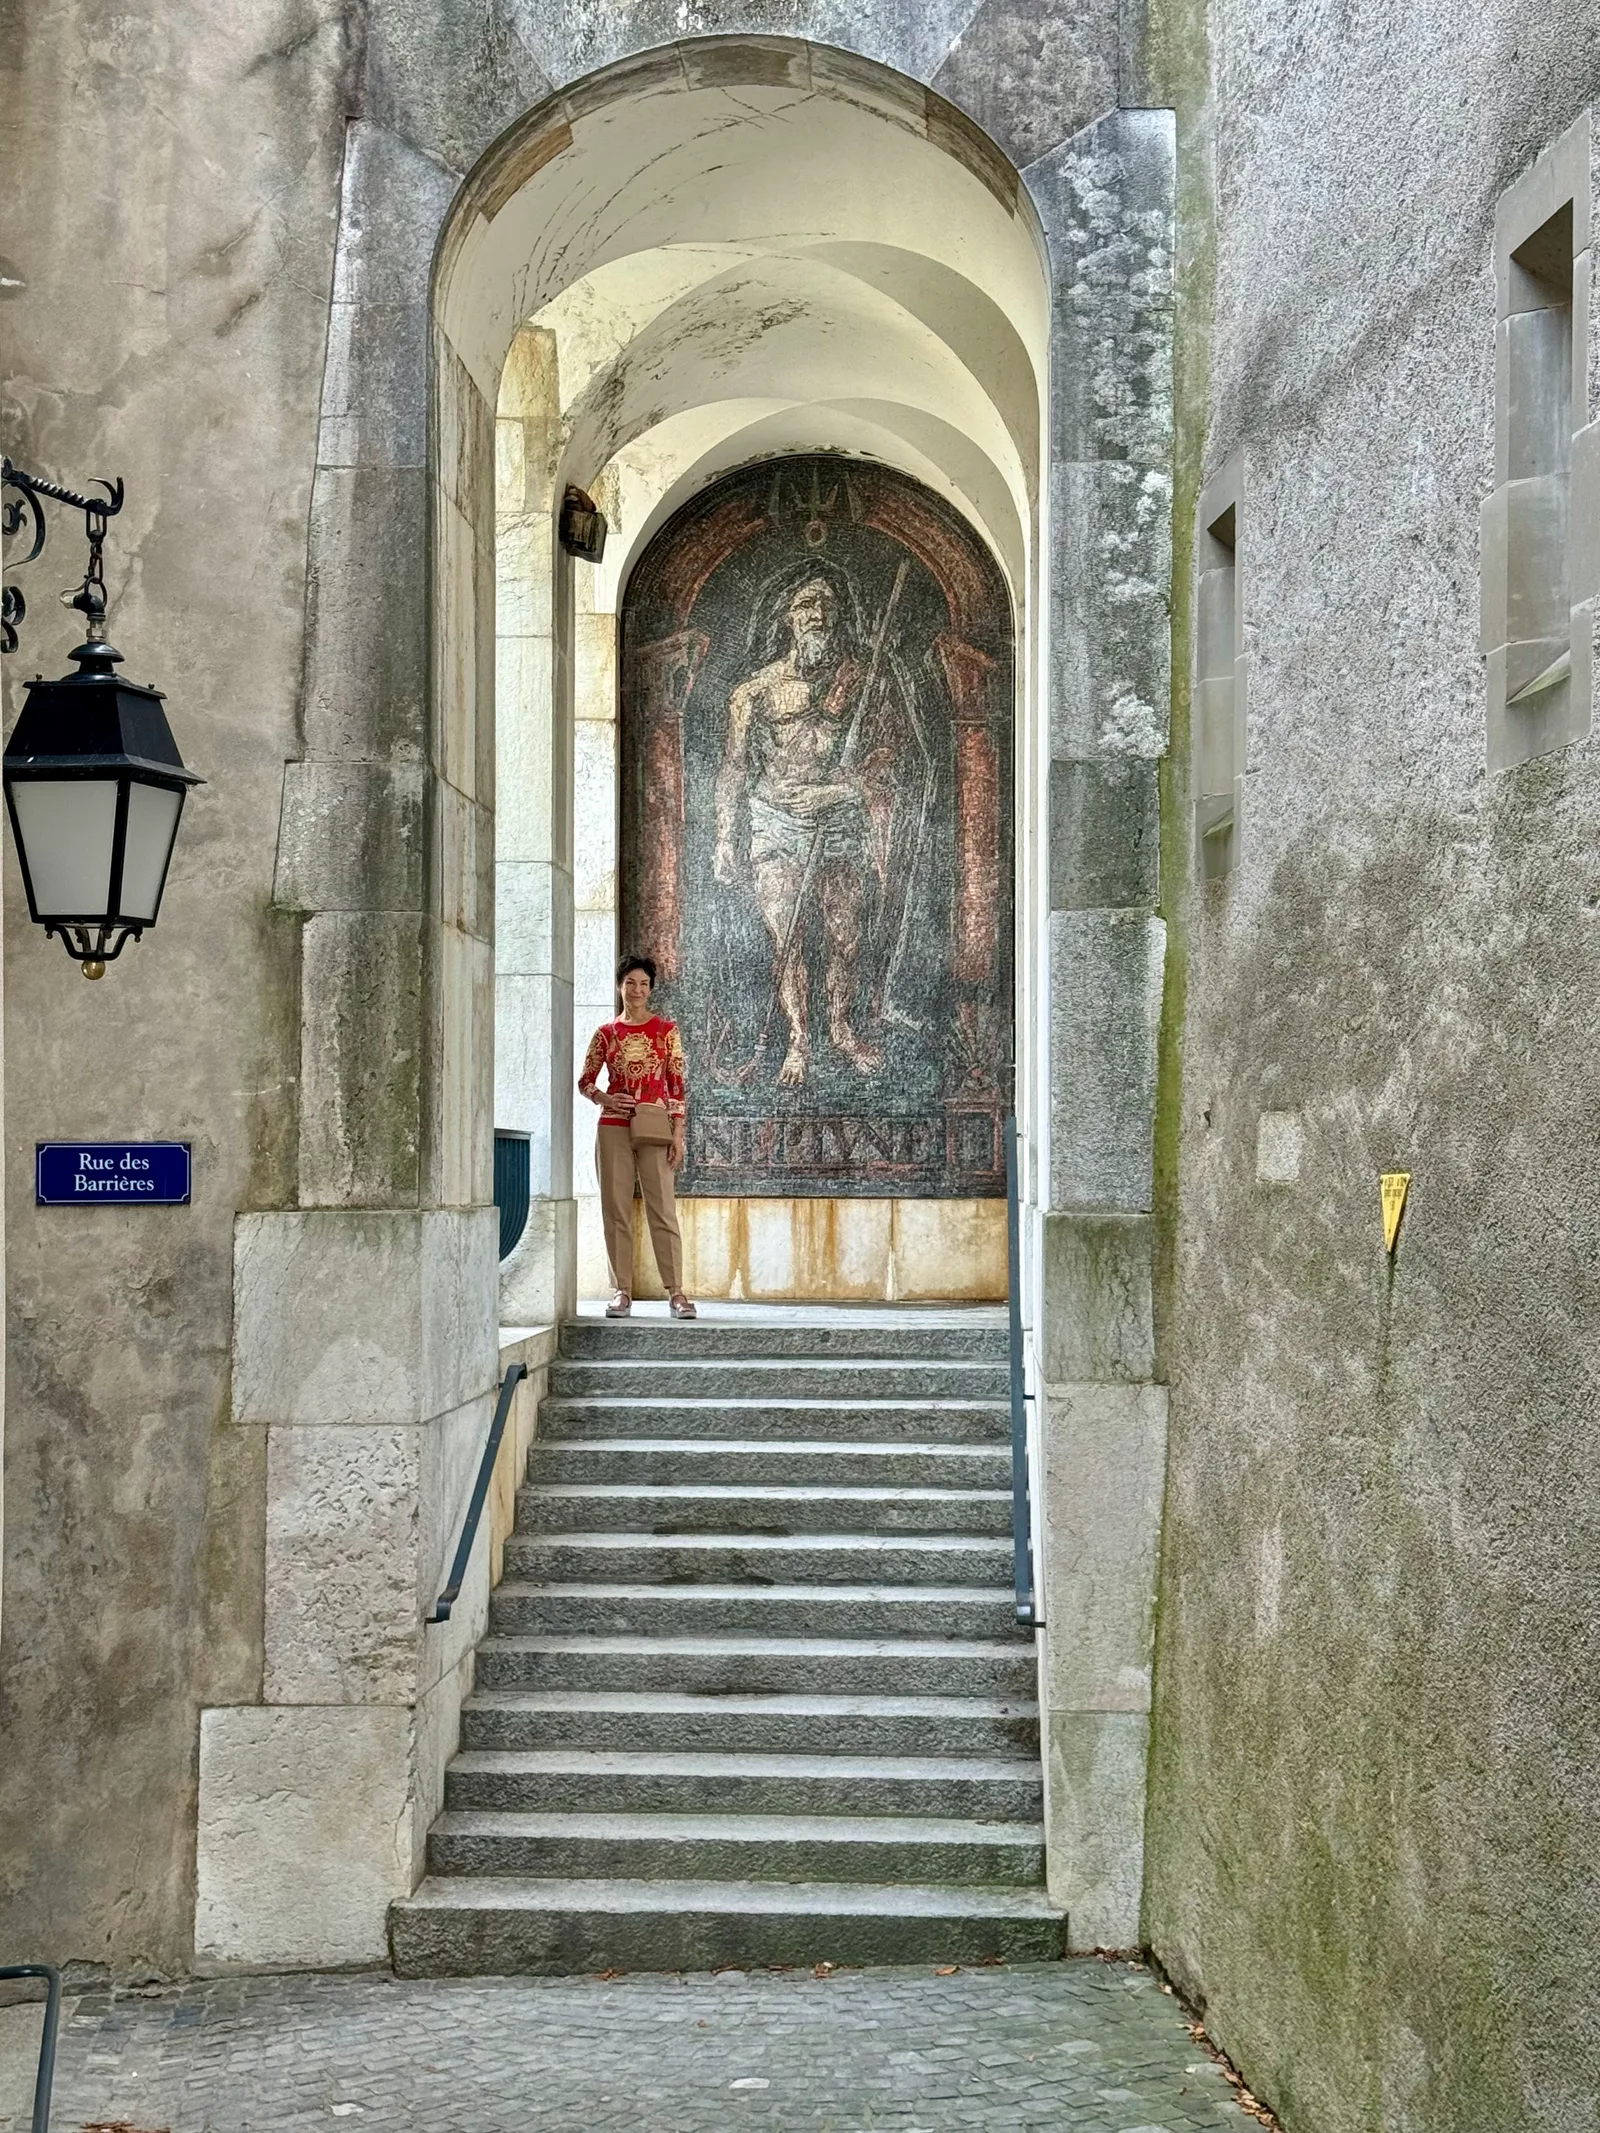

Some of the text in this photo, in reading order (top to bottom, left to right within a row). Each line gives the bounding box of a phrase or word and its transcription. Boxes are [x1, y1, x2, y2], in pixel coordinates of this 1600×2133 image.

[78, 1152, 150, 1170] Rue des
[74, 1174, 155, 1192] Barrières
